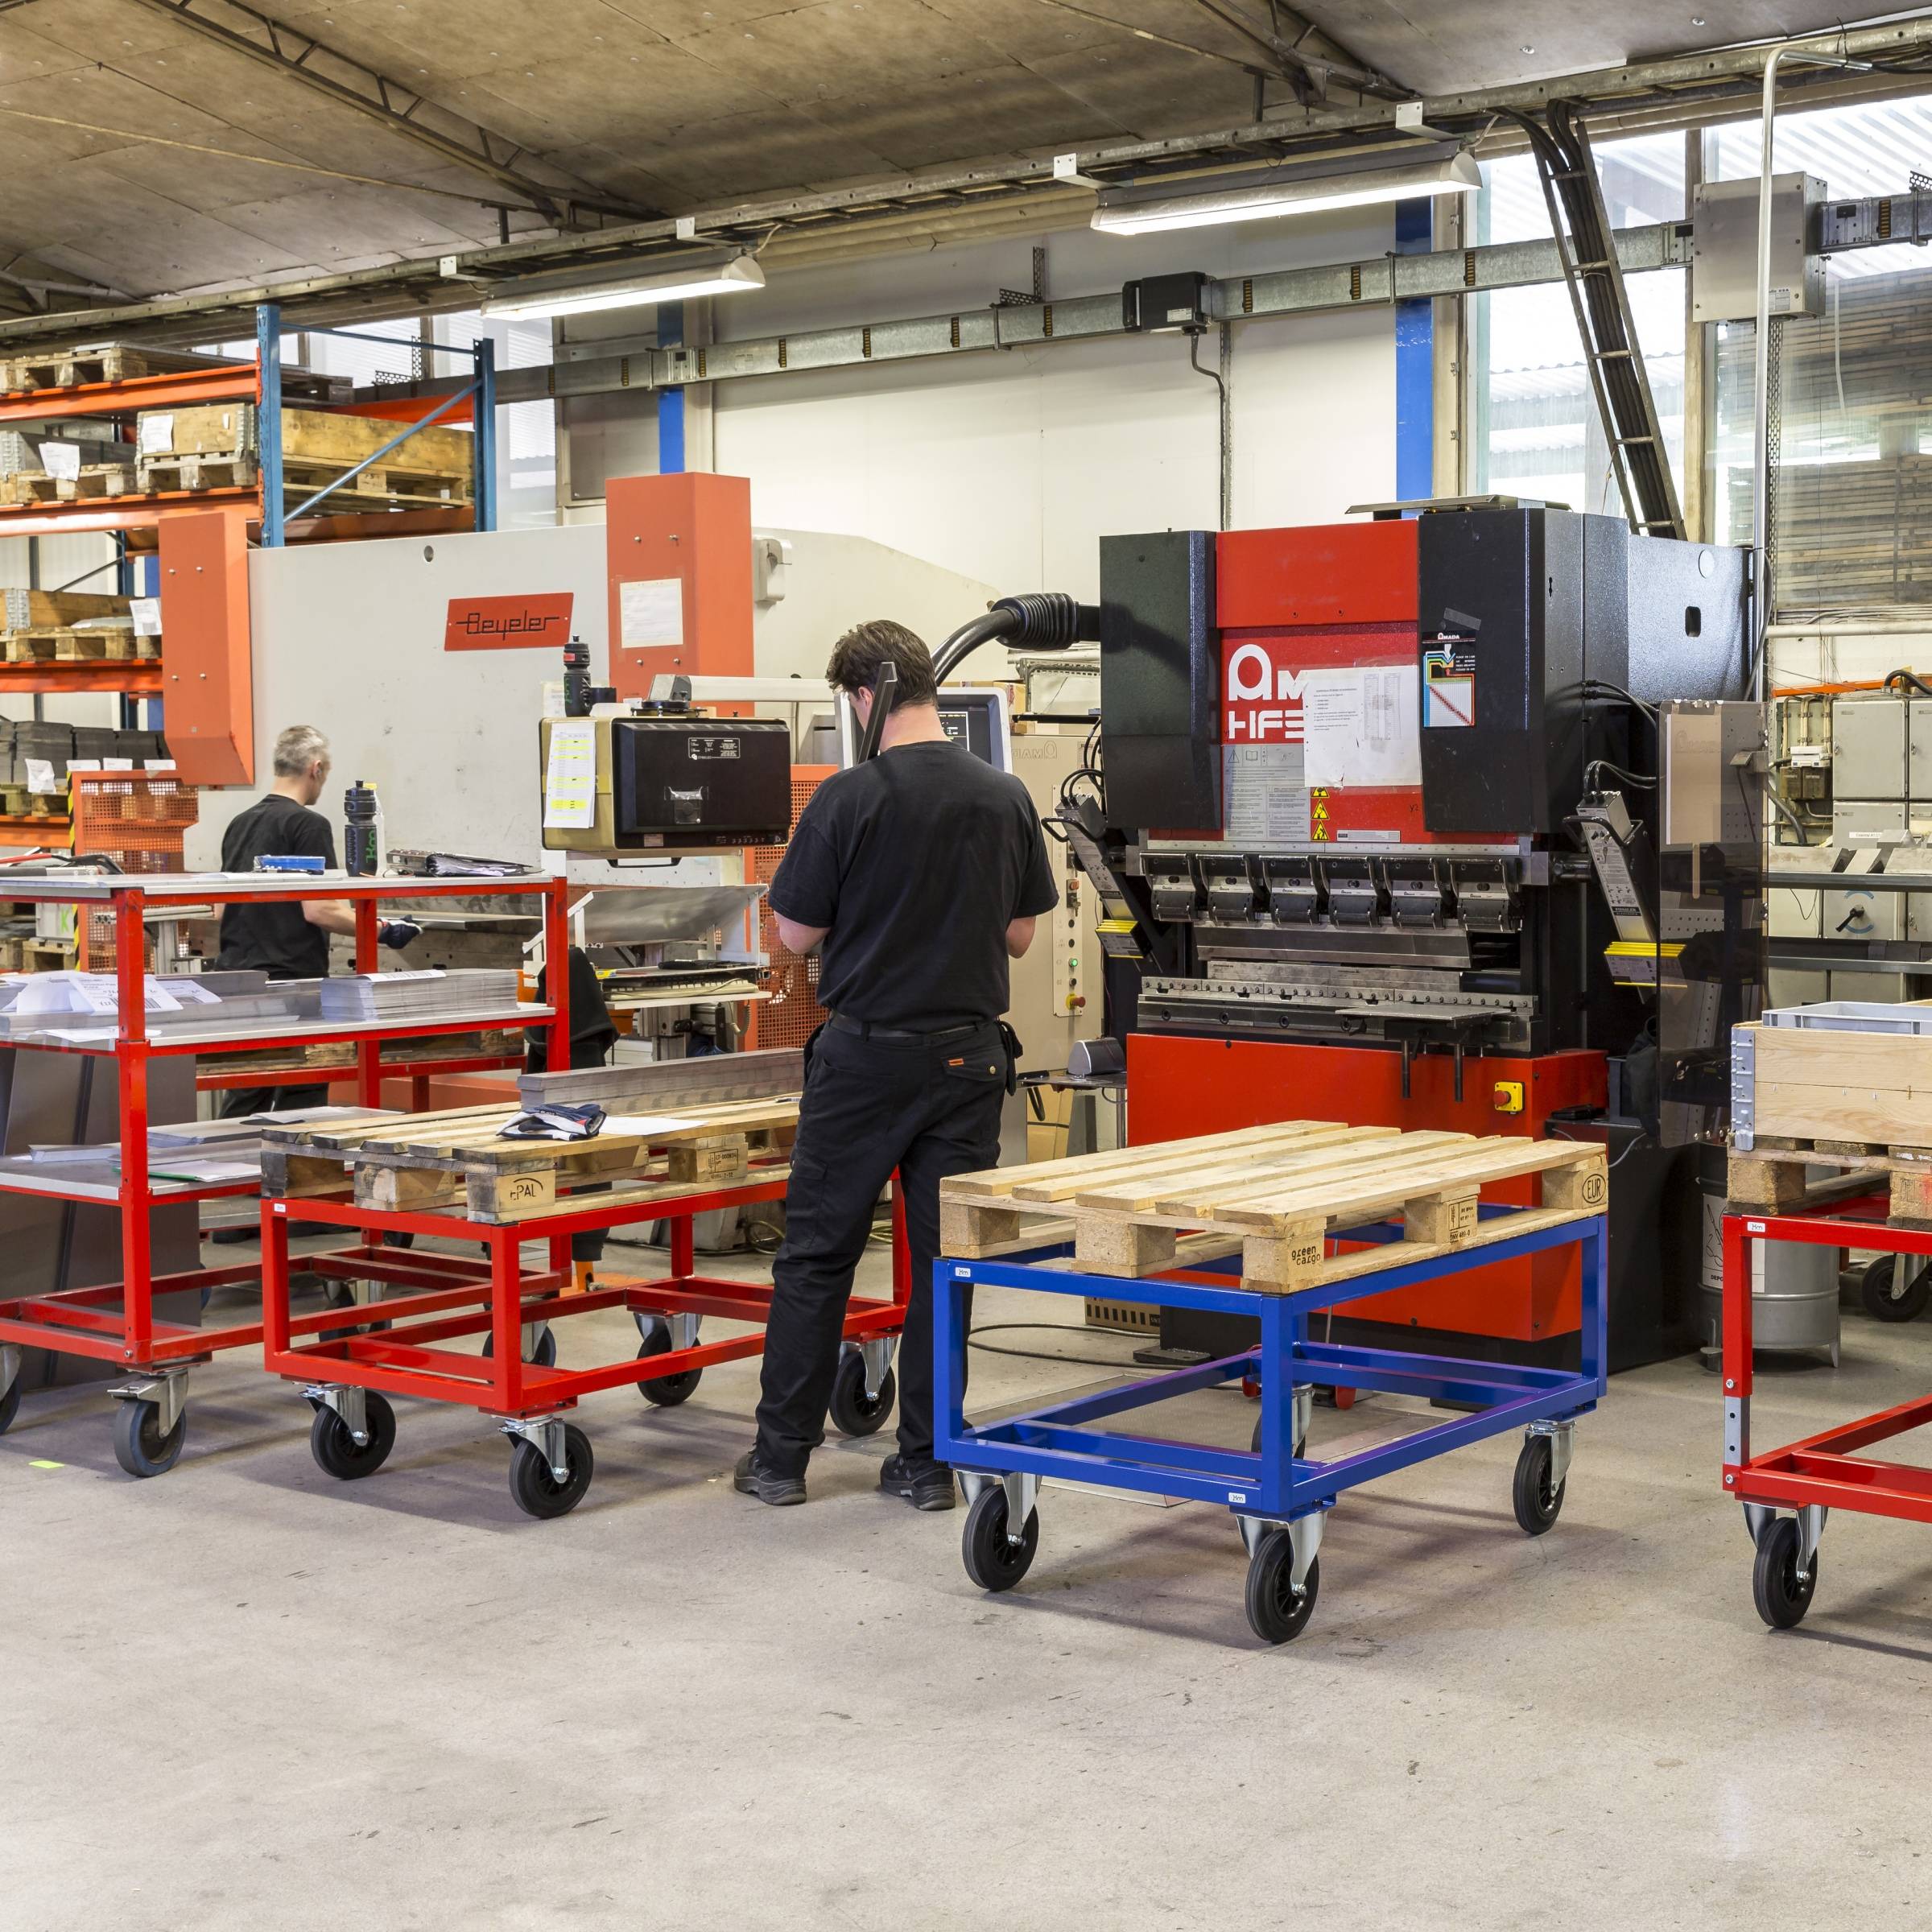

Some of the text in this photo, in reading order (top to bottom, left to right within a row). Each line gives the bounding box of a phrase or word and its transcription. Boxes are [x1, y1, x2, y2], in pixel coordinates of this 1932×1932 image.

[456, 609, 559, 641] Beyeler
[1437, 632, 1460, 640] AMADA
[1587, 1178, 1601, 1199] EUR
[1291, 1245, 1316, 1261] green
[1296, 1253, 1321, 1265] cargo
